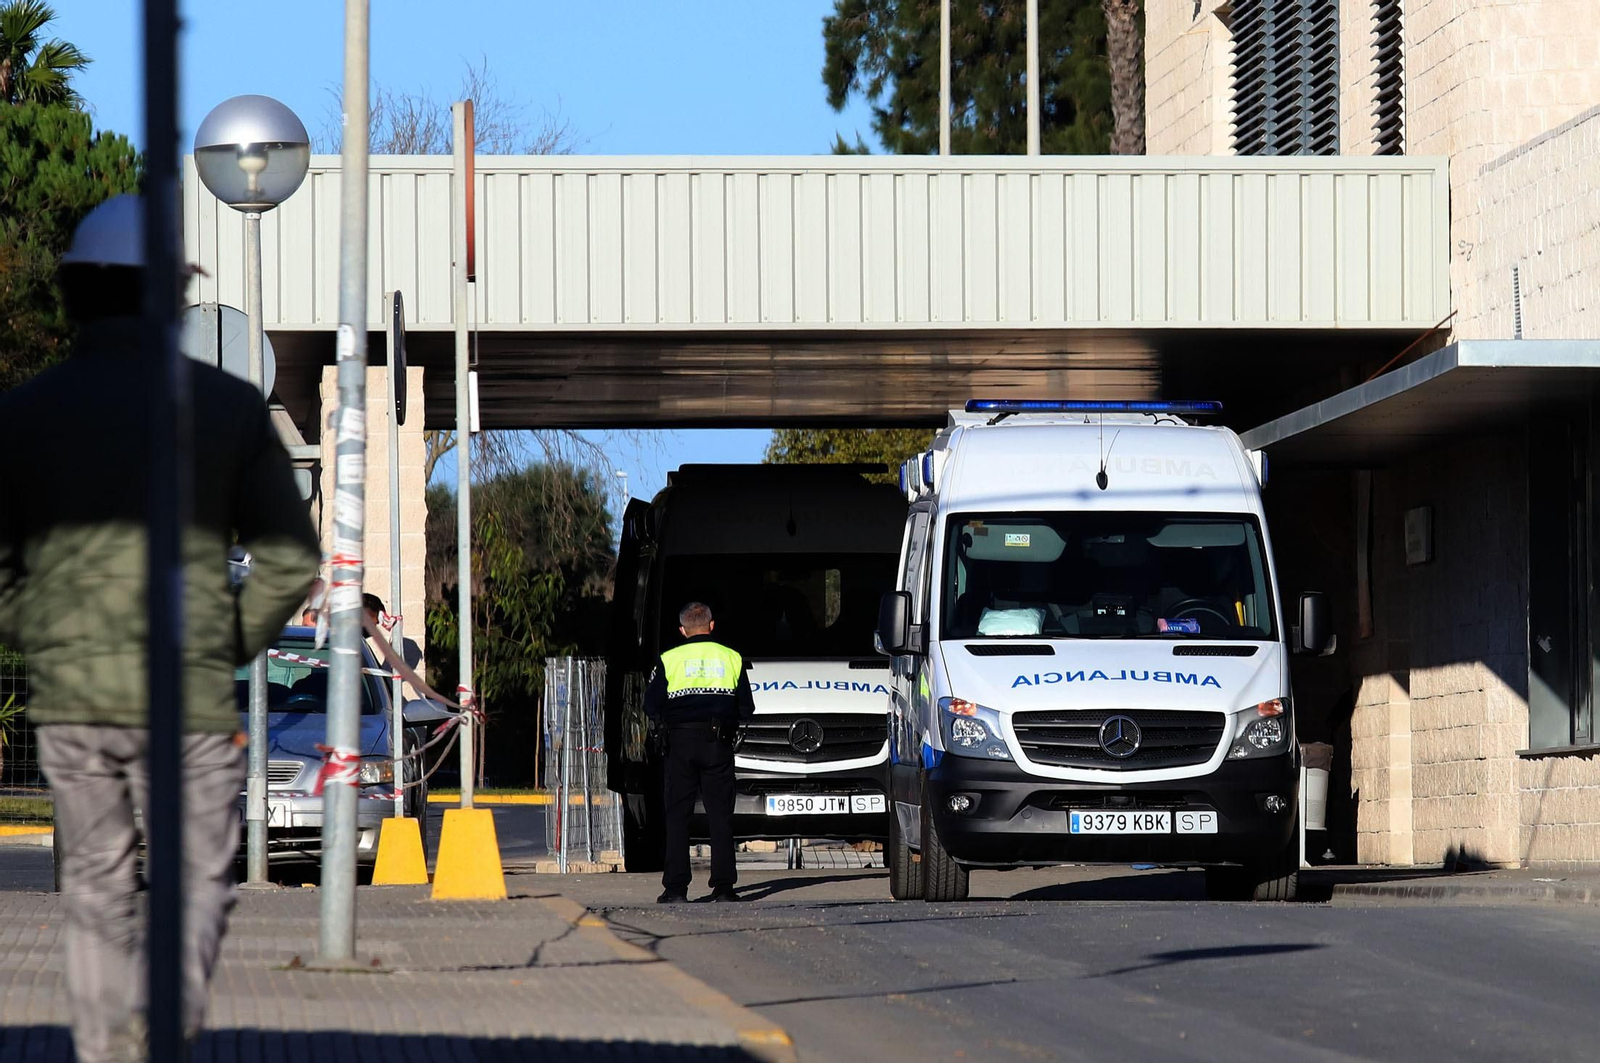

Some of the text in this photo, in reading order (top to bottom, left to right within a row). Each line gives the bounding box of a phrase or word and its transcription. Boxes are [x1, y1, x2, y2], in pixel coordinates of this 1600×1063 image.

[777, 798, 846, 812] 9850 JTW
[1083, 814, 1165, 831] 9379 KBK
